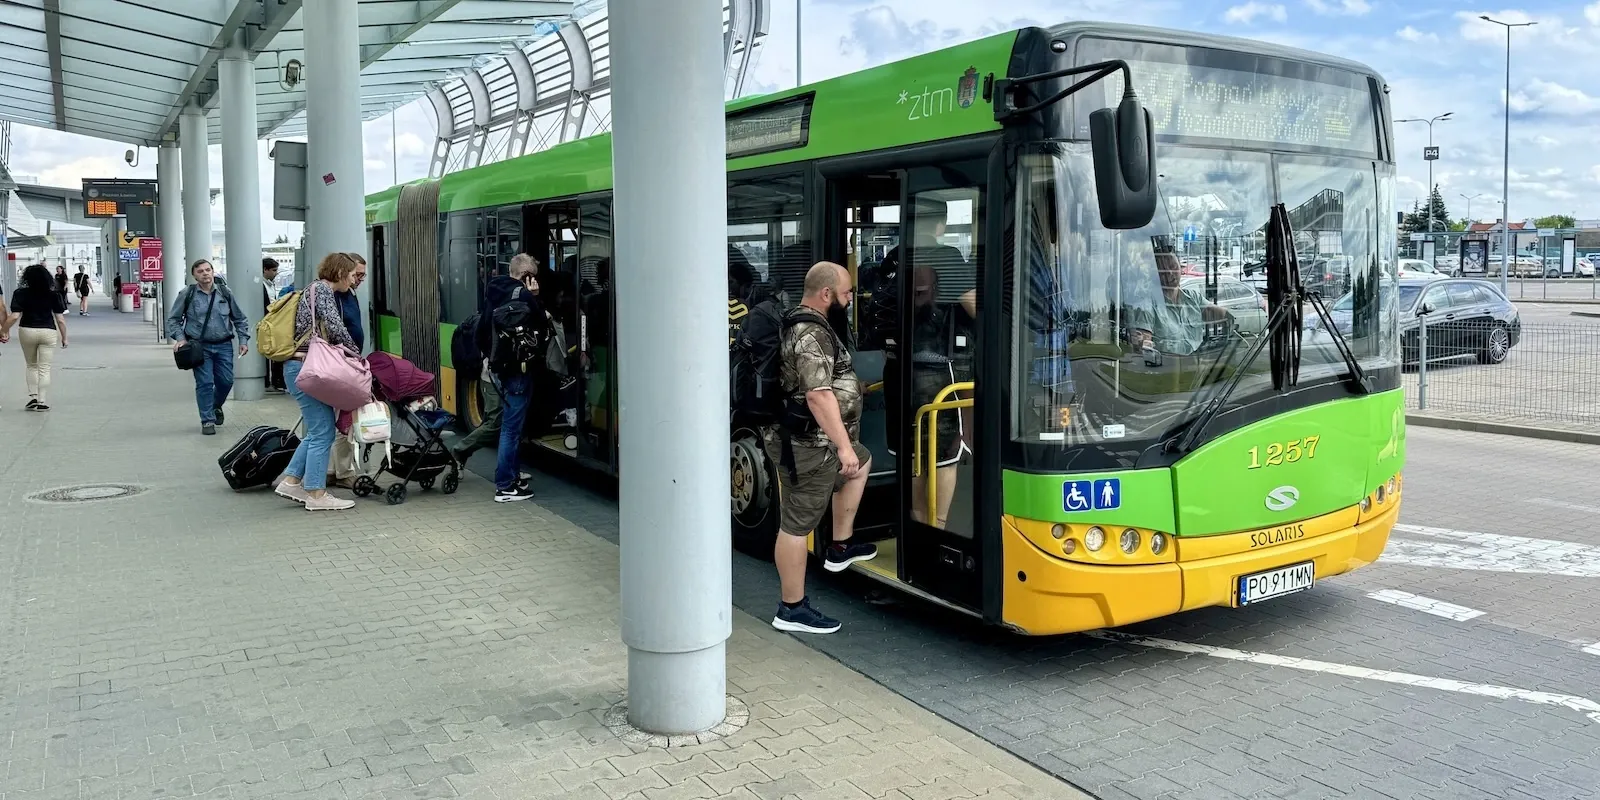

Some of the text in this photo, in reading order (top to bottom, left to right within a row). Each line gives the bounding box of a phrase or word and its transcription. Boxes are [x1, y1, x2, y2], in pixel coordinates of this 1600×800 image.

[1060, 407, 1070, 427] 3
[1248, 434, 1320, 470] 1257
[1250, 524, 1304, 548] SOLARIS
[1249, 576, 1268, 598] PO
[1272, 565, 1312, 592] 911MN
